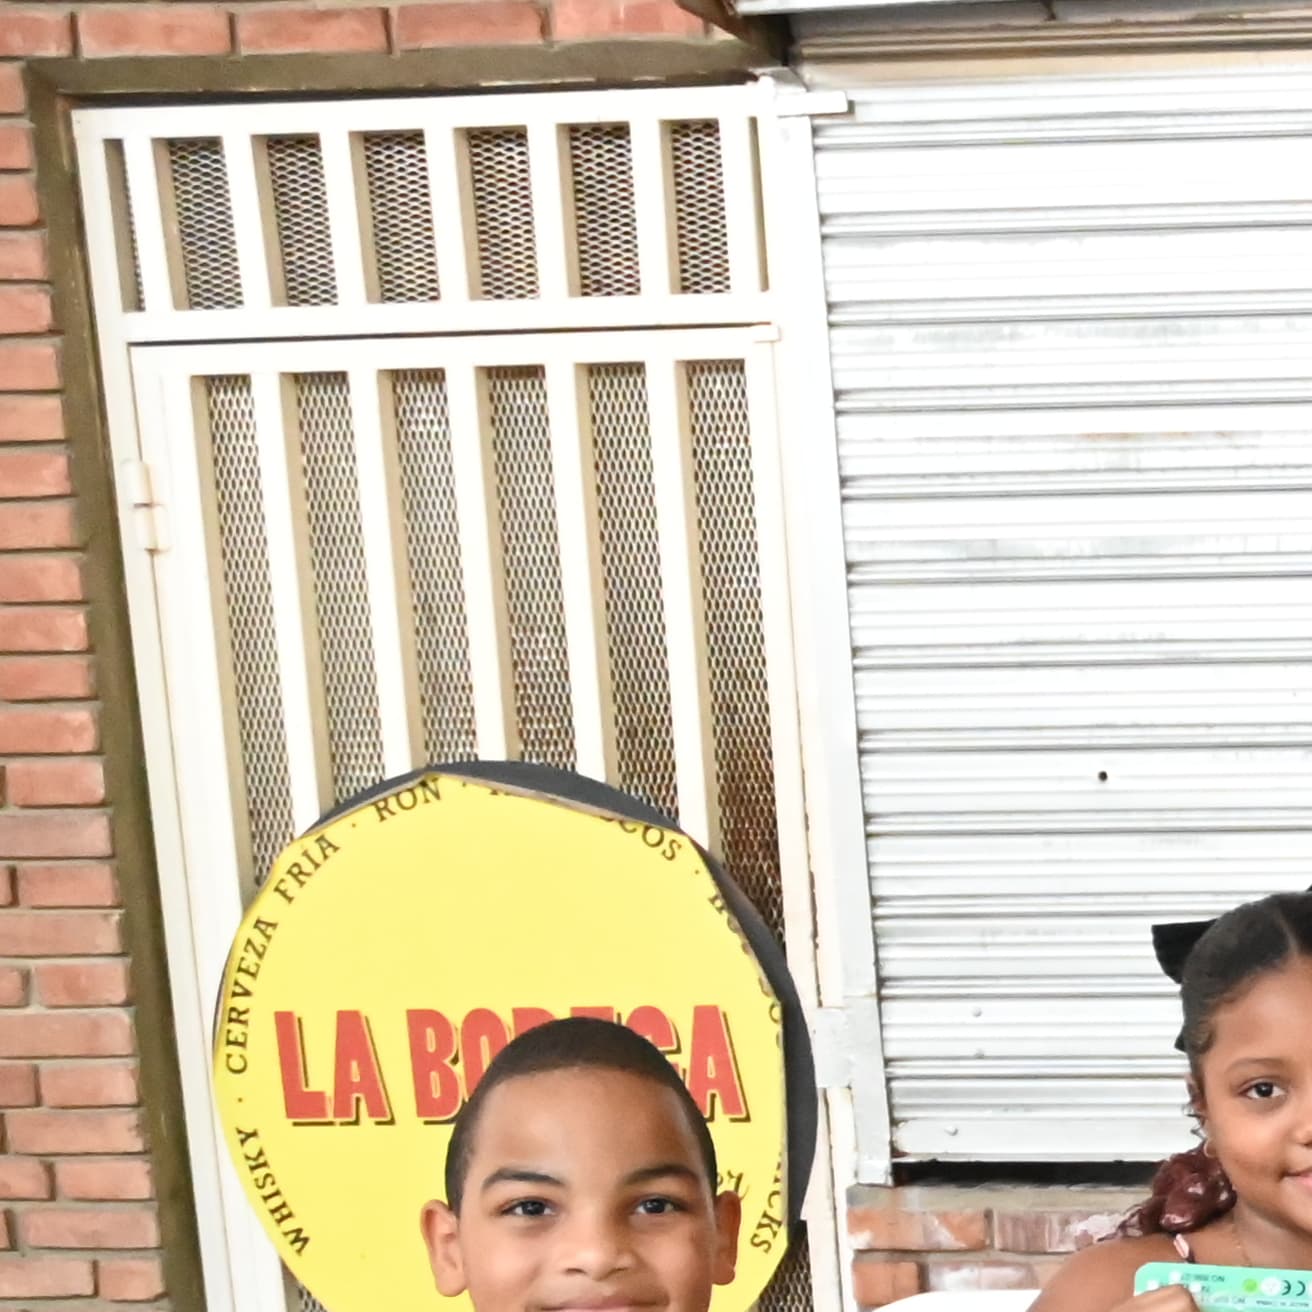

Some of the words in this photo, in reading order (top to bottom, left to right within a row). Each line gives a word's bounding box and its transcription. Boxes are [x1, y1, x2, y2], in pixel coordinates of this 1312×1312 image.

[372, 777, 443, 823] RON
[225, 916, 278, 1075] CERVEZA
[274, 1009, 395, 1126] LA
[405, 1004, 751, 1125] BOA
[235, 1127, 310, 1256] WHISKY
